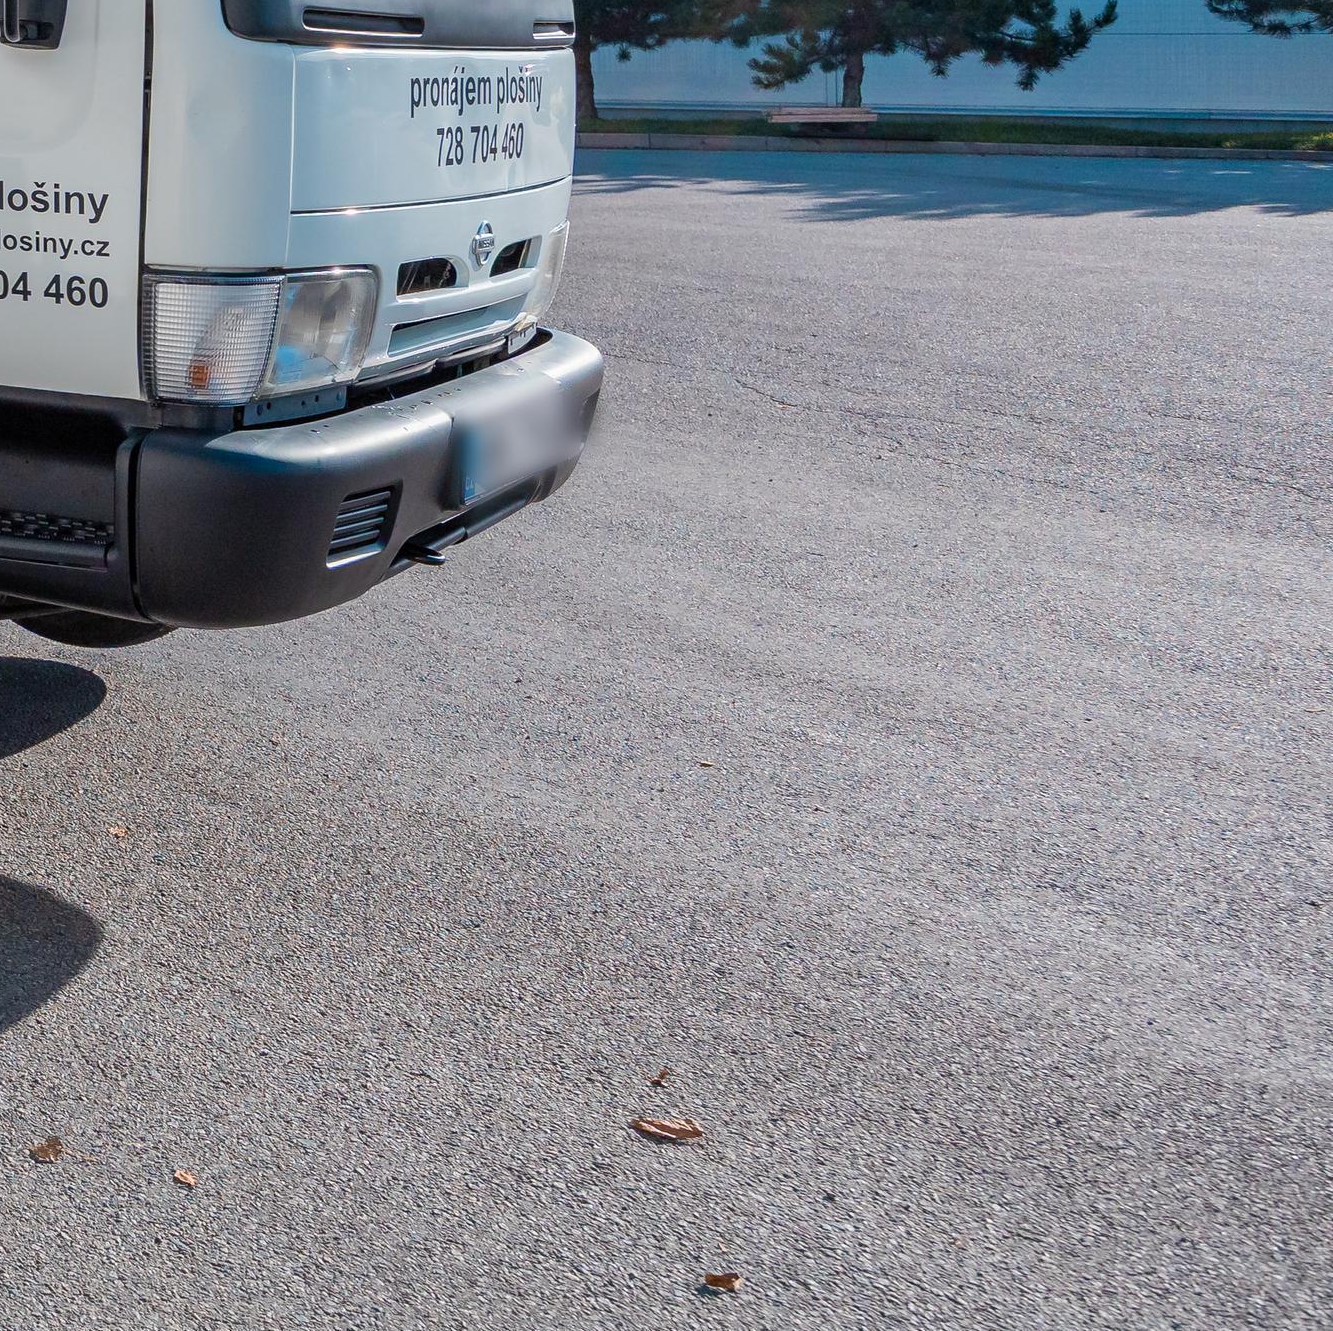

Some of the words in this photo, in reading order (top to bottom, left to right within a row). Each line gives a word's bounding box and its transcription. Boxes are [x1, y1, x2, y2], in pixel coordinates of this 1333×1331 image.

[410, 65, 492, 119] pronájem
[496, 65, 543, 114] plošiny
[436, 125, 464, 167] 728
[470, 124, 498, 164] 704
[501, 122, 524, 160] 460
[43, 274, 109, 309] 460
